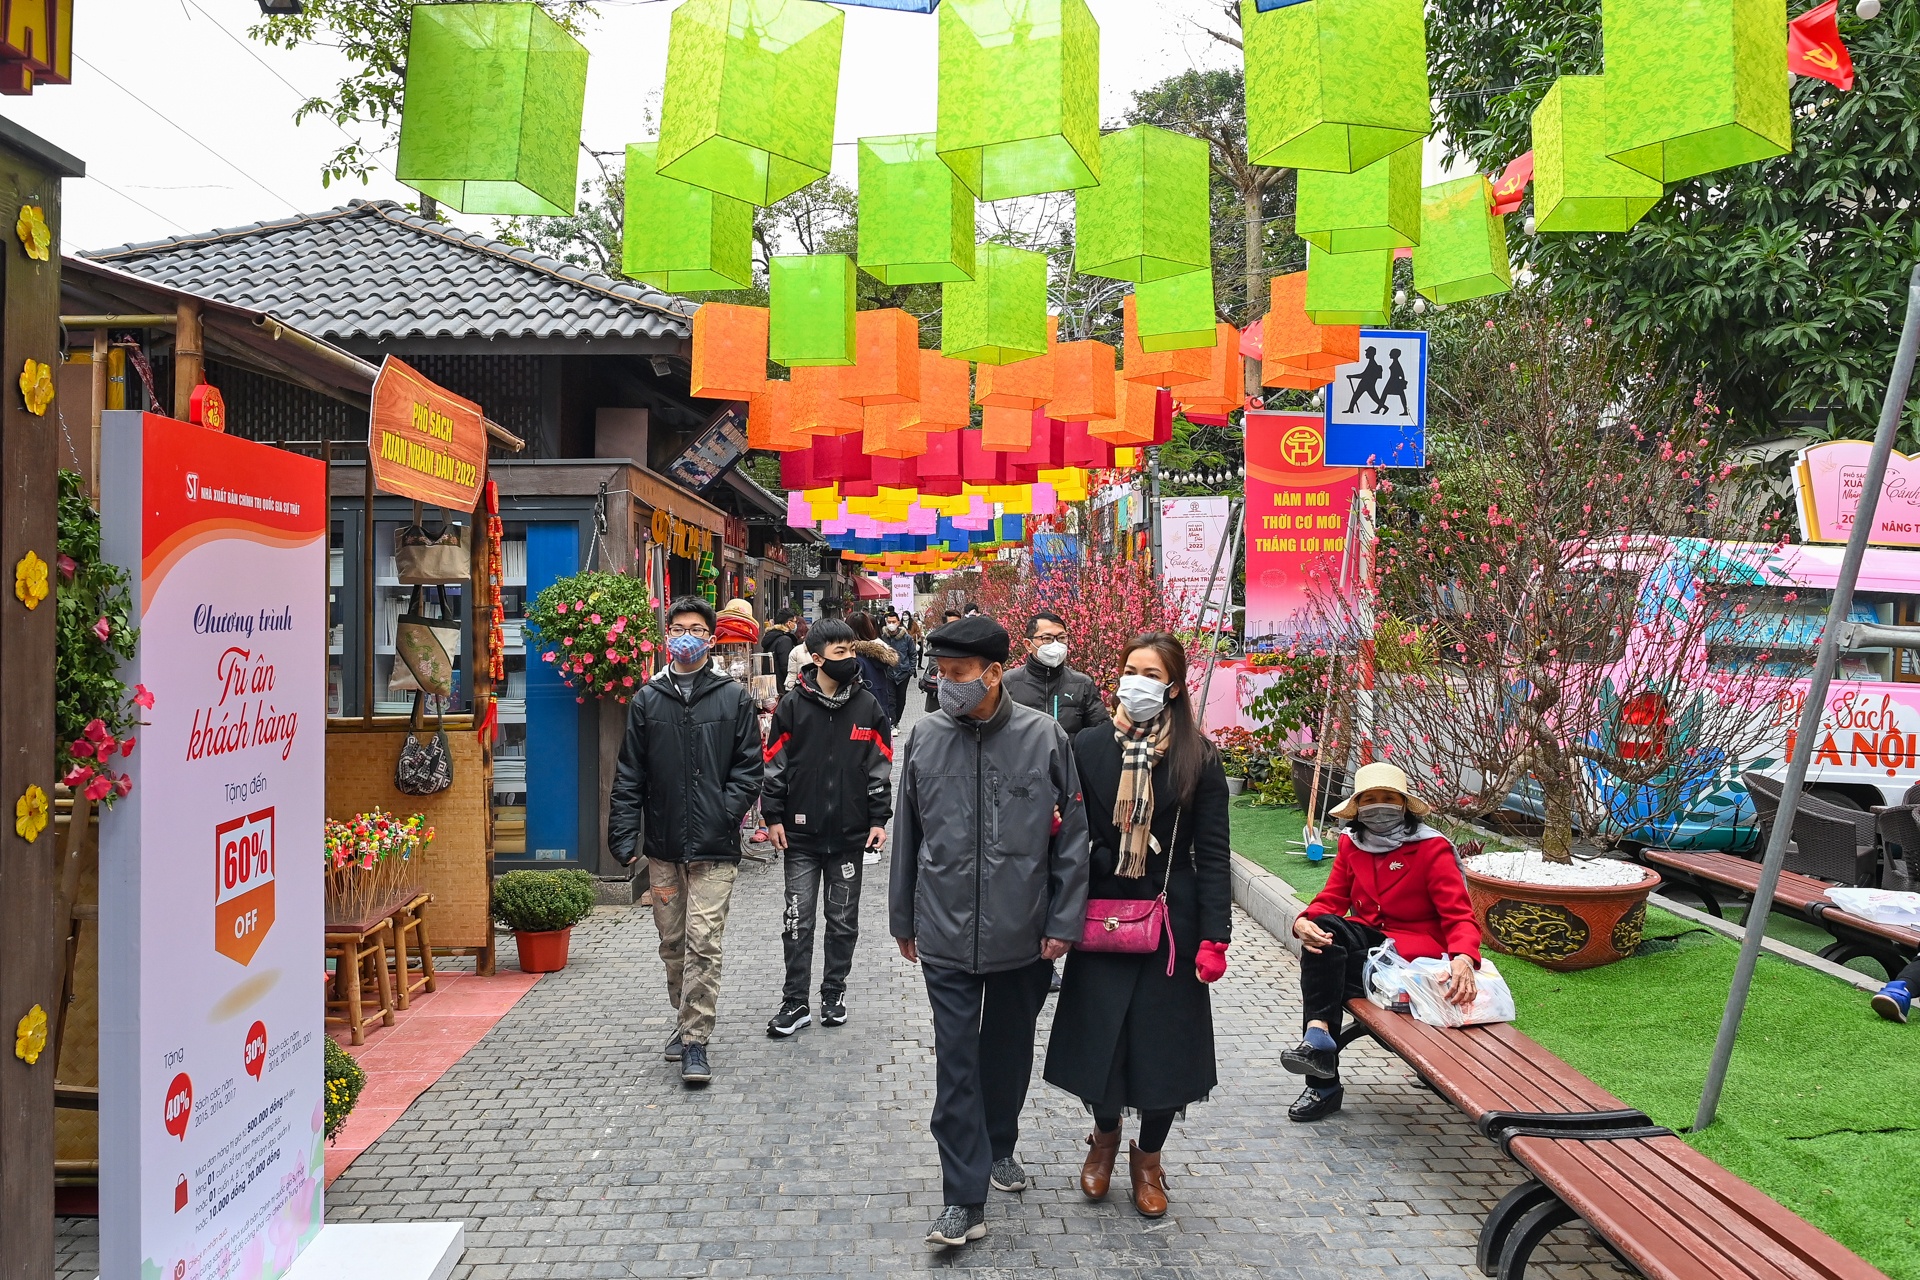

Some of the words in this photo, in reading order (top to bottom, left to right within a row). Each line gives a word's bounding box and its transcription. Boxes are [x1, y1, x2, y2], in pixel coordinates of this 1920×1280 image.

[411, 400, 430, 433] PHỐ
[429, 410, 454, 443] SÁCH
[381, 430, 408, 466] XUÂN
[408, 442, 434, 476] NHÂM
[435, 446, 455, 481] DẦN
[455, 460, 476, 488] 2022
[186, 473, 199, 500] ST
[1273, 491, 1301, 507] NĂM
[1305, 490, 1330, 507] MỚI
[1843, 478, 1863, 488] XUÂ
[201, 486, 213, 501] NHÀ
[213, 487, 227, 503] XUẤT
[227, 489, 238, 505] BẢN
[239, 493, 254, 507] CHÍNH
[254, 497, 262, 511] TRỊ
[262, 496, 275, 511] QUỐC
[275, 501, 283, 513] GIA
[1262, 513, 1291, 530] THỜI
[1295, 515, 1313, 530] CƠ
[1316, 516, 1341, 530] MỚI
[1841, 514, 1856, 524] 20
[1881, 520, 1912, 533] NÂNG
[1255, 536, 1297, 552] THẮNG
[1300, 537, 1321, 554] LỢI
[193, 603, 254, 639] Chương
[258, 604, 293, 632] trình
[217, 646, 251, 707] Tri
[251, 653, 276, 694] ân
[1832, 691, 1899, 732] Sách
[186, 701, 251, 762] khách
[251, 699, 298, 761] hàng
[1850, 728, 1917, 777] NỘI
[224, 783, 248, 805] Tặng
[249, 772, 267, 796] đến
[224, 829, 268, 890] 60%
[234, 908, 258, 940] OFF
[245, 1033, 265, 1065] 30%
[290, 1030, 300, 1043] năm
[163, 1047, 184, 1070] Tặng
[165, 1087, 190, 1123] 40%
[194, 1095, 209, 1113] Sách
[210, 1087, 221, 1101] các
[221, 1077, 234, 1092] năm
[225, 1087, 236, 1105] 2017
[247, 1107, 268, 1134] 500.000
[269, 1097, 283, 1115] đồng
[207, 1170, 215, 1186] 01
[209, 1193, 230, 1220] 10.000
[230, 1180, 246, 1201] đồng
[247, 1159, 265, 1185] 20.000
[266, 1147, 280, 1167] đồng
[208, 1187, 216, 1203] 01
